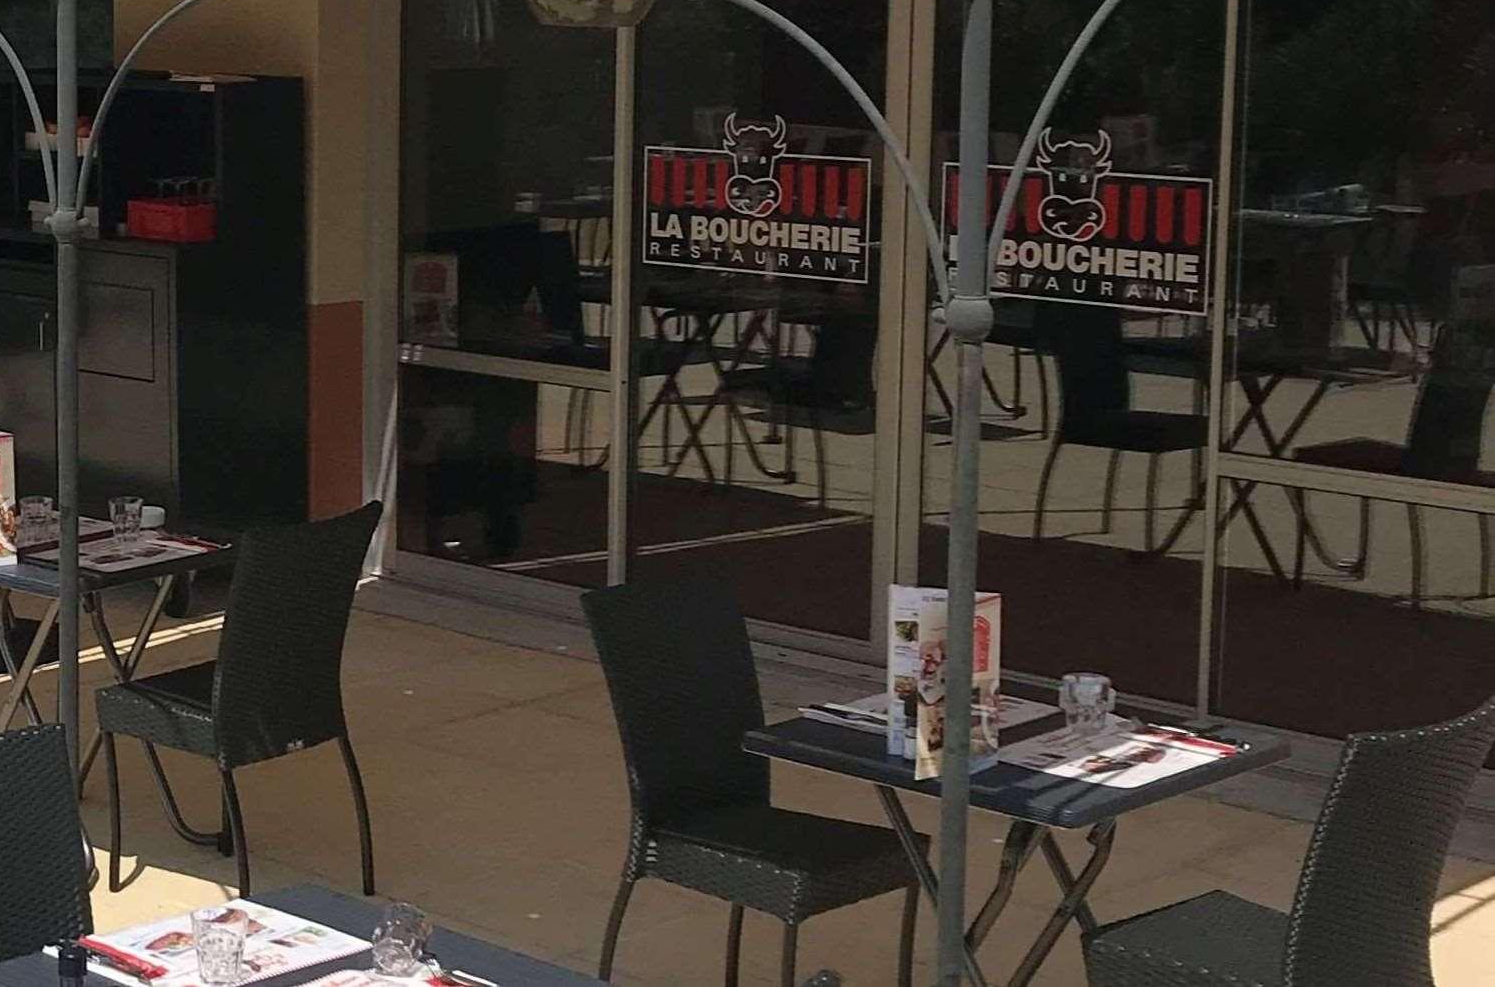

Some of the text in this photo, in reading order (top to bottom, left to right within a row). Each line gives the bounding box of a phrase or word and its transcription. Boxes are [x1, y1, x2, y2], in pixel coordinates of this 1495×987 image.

[650, 212, 861, 254] LA BOUCHERIE
[649, 242, 861, 273] RESTAURANT
[995, 238, 1200, 284] BOUCHERIE
[948, 267, 1199, 304] STAURANT
